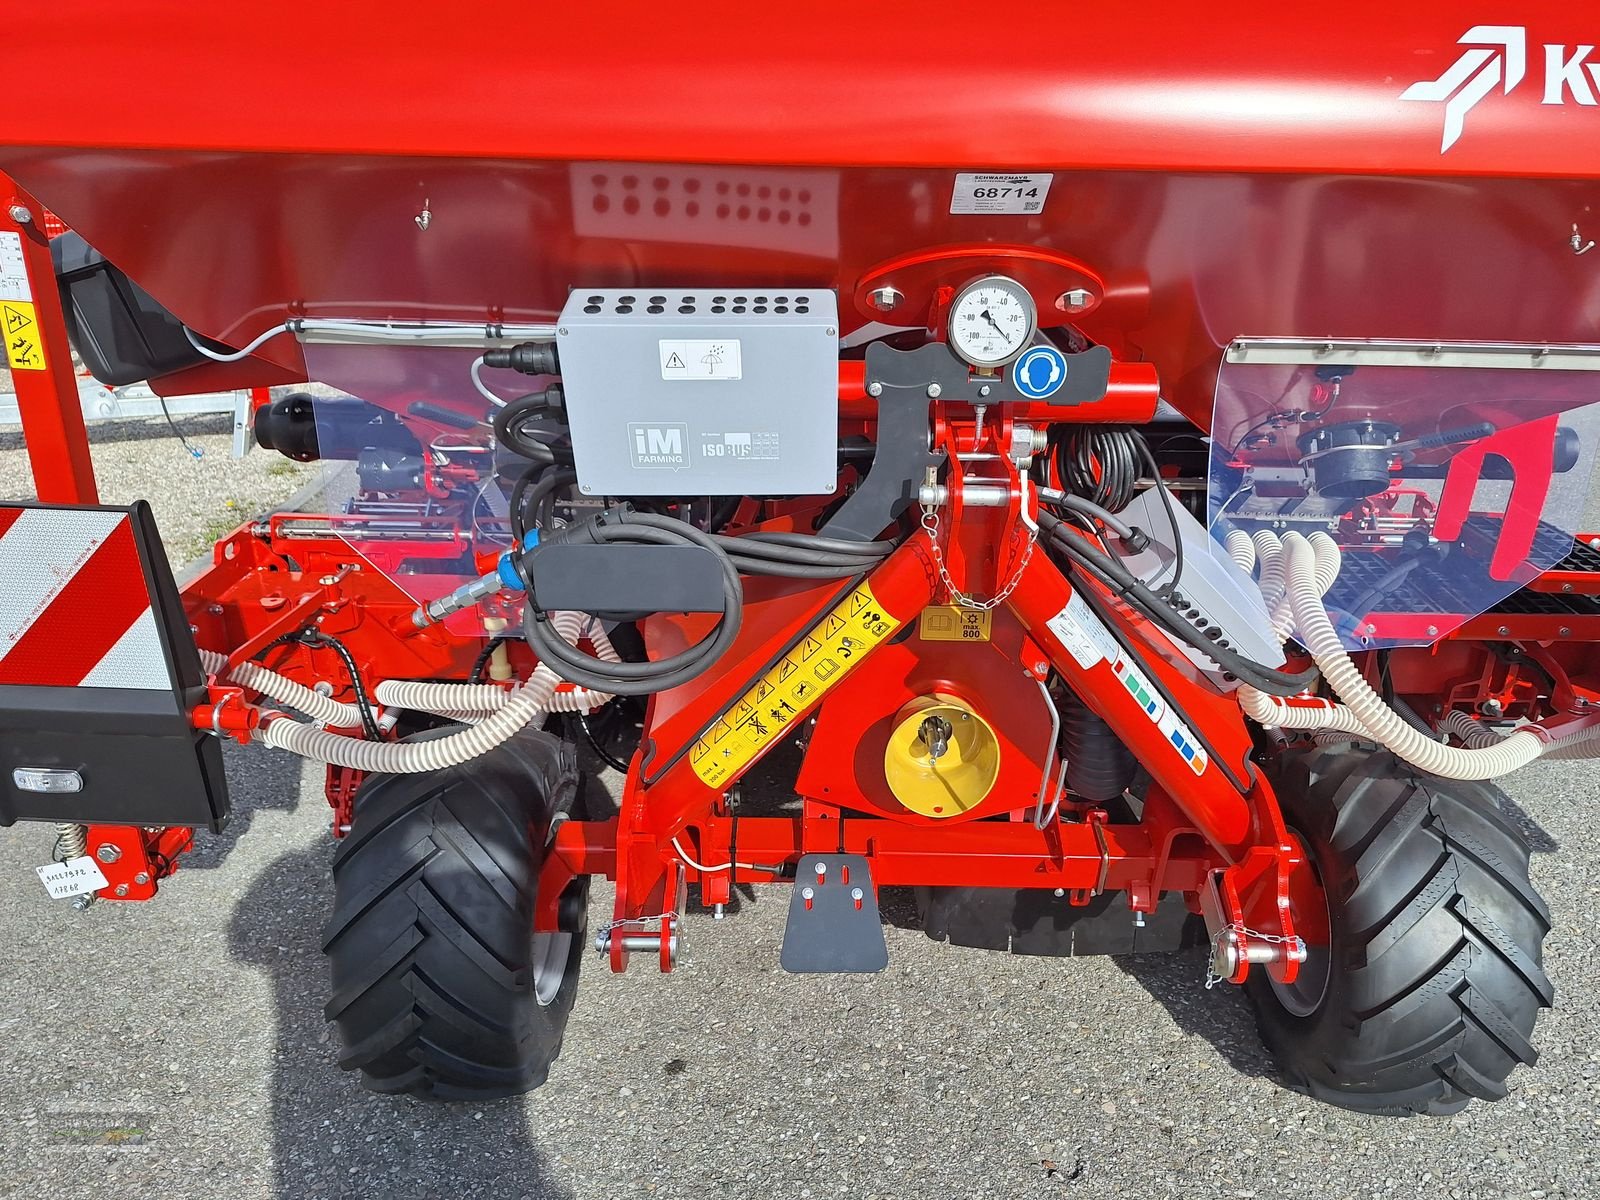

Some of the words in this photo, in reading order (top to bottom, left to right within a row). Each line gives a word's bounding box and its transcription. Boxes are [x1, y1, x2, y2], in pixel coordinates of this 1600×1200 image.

[973, 187, 1038, 198] 68714
[634, 428, 682, 454] iM
[702, 444, 751, 457] ISOBUS
[638, 455, 683, 463] FARMING
[962, 630, 980, 638] 800
